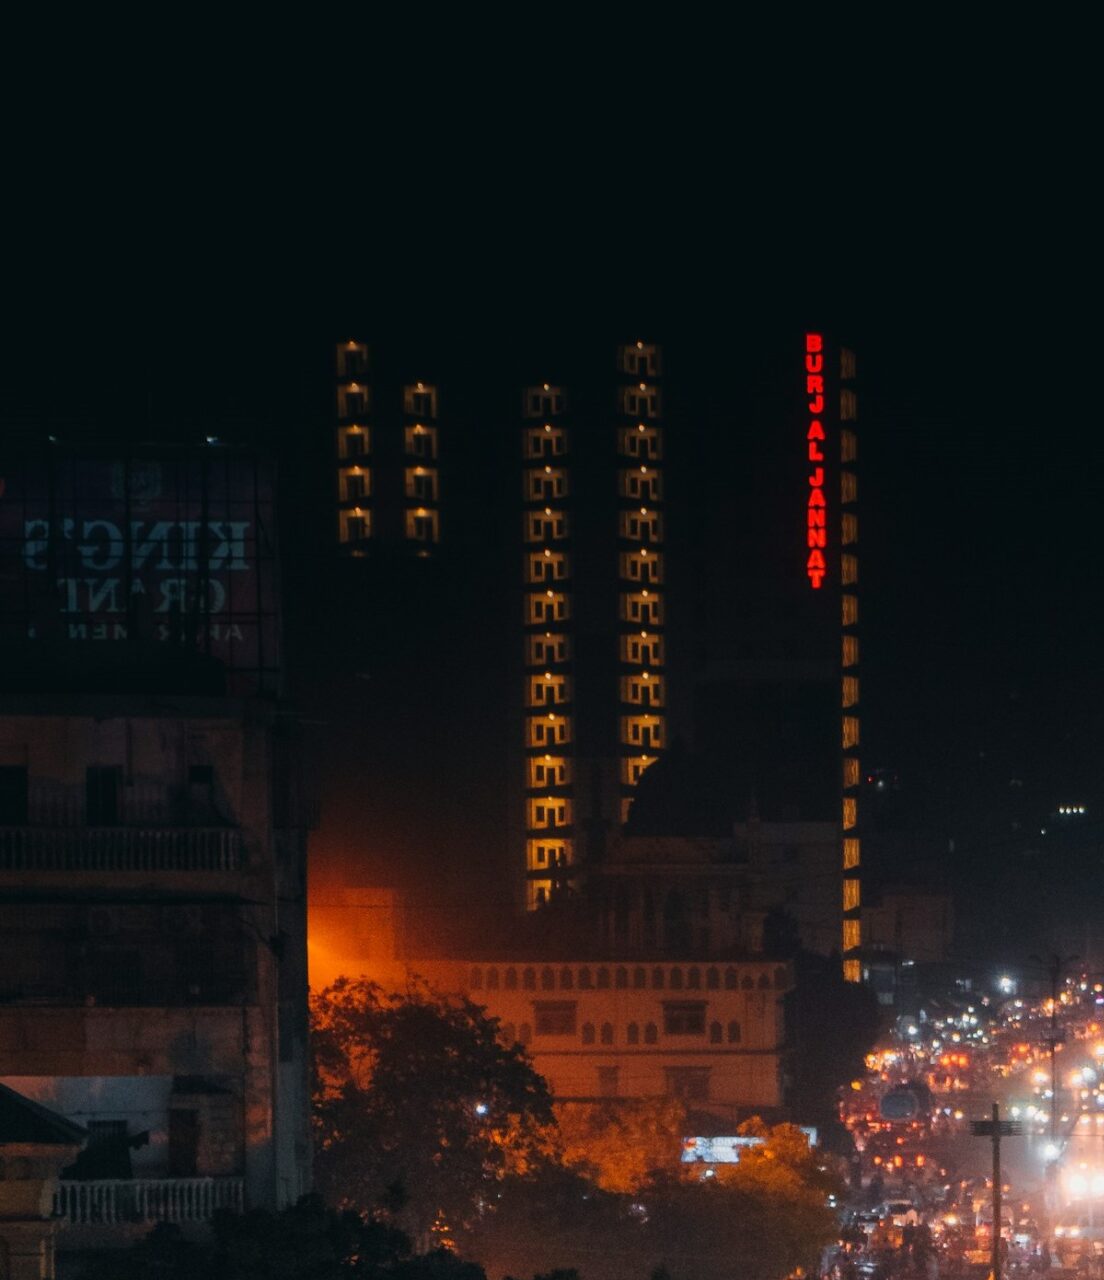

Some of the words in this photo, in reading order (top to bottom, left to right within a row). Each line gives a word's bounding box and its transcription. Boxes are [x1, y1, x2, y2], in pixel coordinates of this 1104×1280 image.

[805, 333, 824, 414] BURJ
[806, 419, 826, 461] AL
[806, 467, 827, 589] JANNAT
